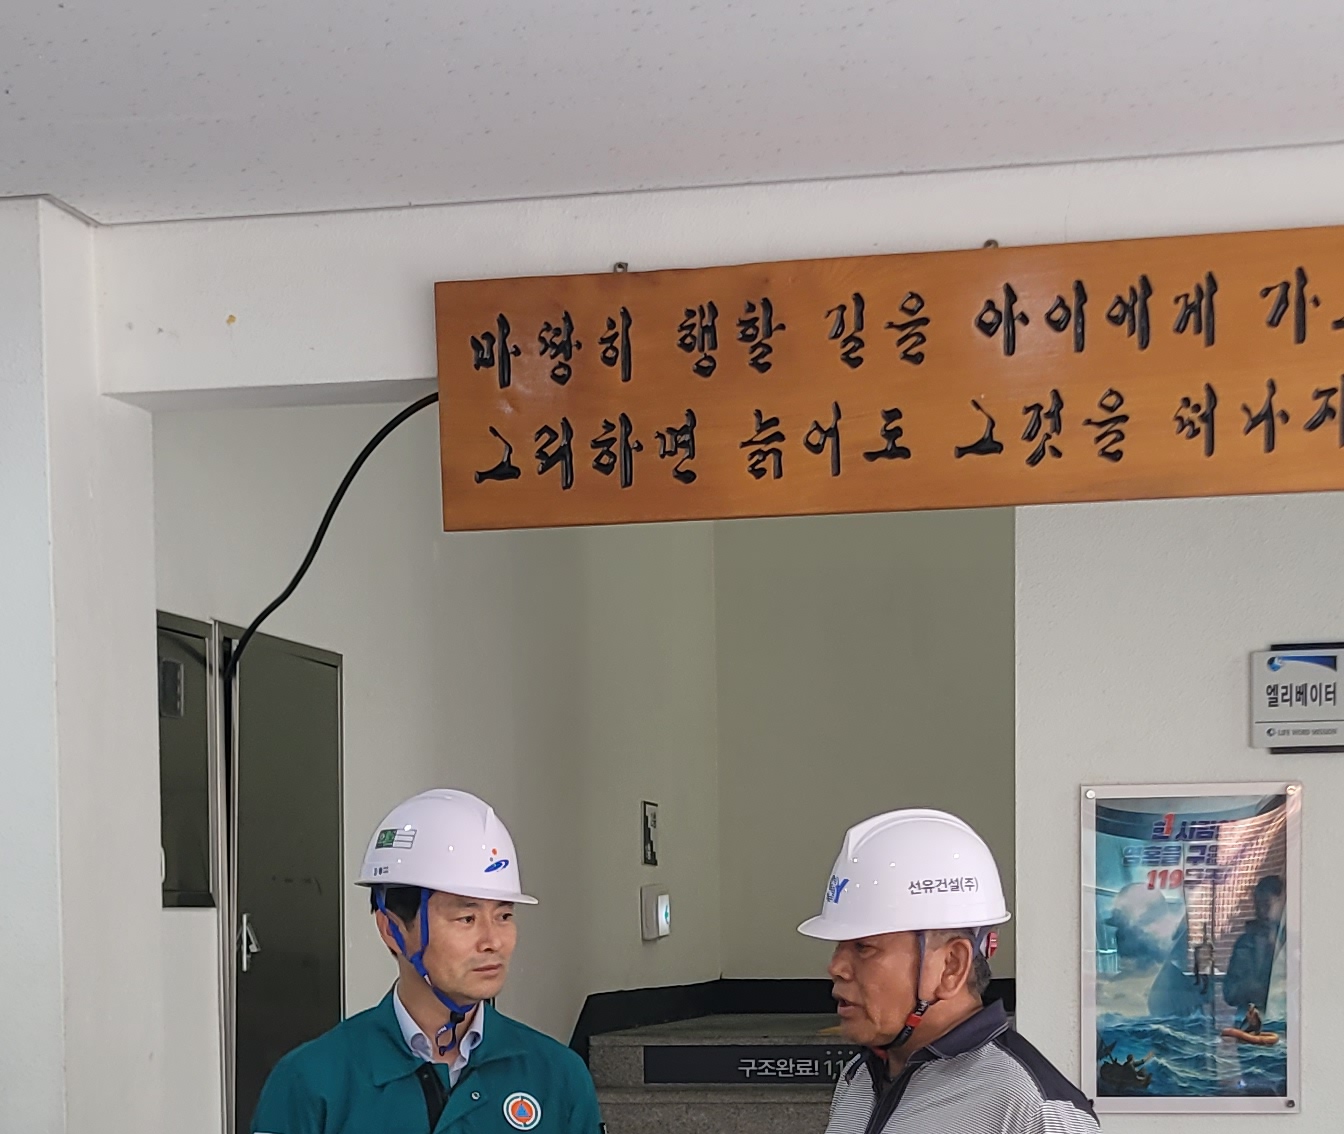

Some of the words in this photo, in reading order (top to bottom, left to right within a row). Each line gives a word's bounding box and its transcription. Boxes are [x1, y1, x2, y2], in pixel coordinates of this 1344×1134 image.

[469, 305, 633, 390] 마땅히
[676, 296, 787, 379] 행할
[824, 291, 931, 369] 길을
[975, 271, 1219, 357] 아이에게
[474, 408, 698, 492] 그리하면
[739, 400, 912, 480] 늙어도
[954, 388, 1130, 468] 그것을
[1265, 681, 1337, 708] 엘리베이터
[907, 876, 979, 895] 선유건설(주)
[737, 1058, 819, 1078] 구조완료!
